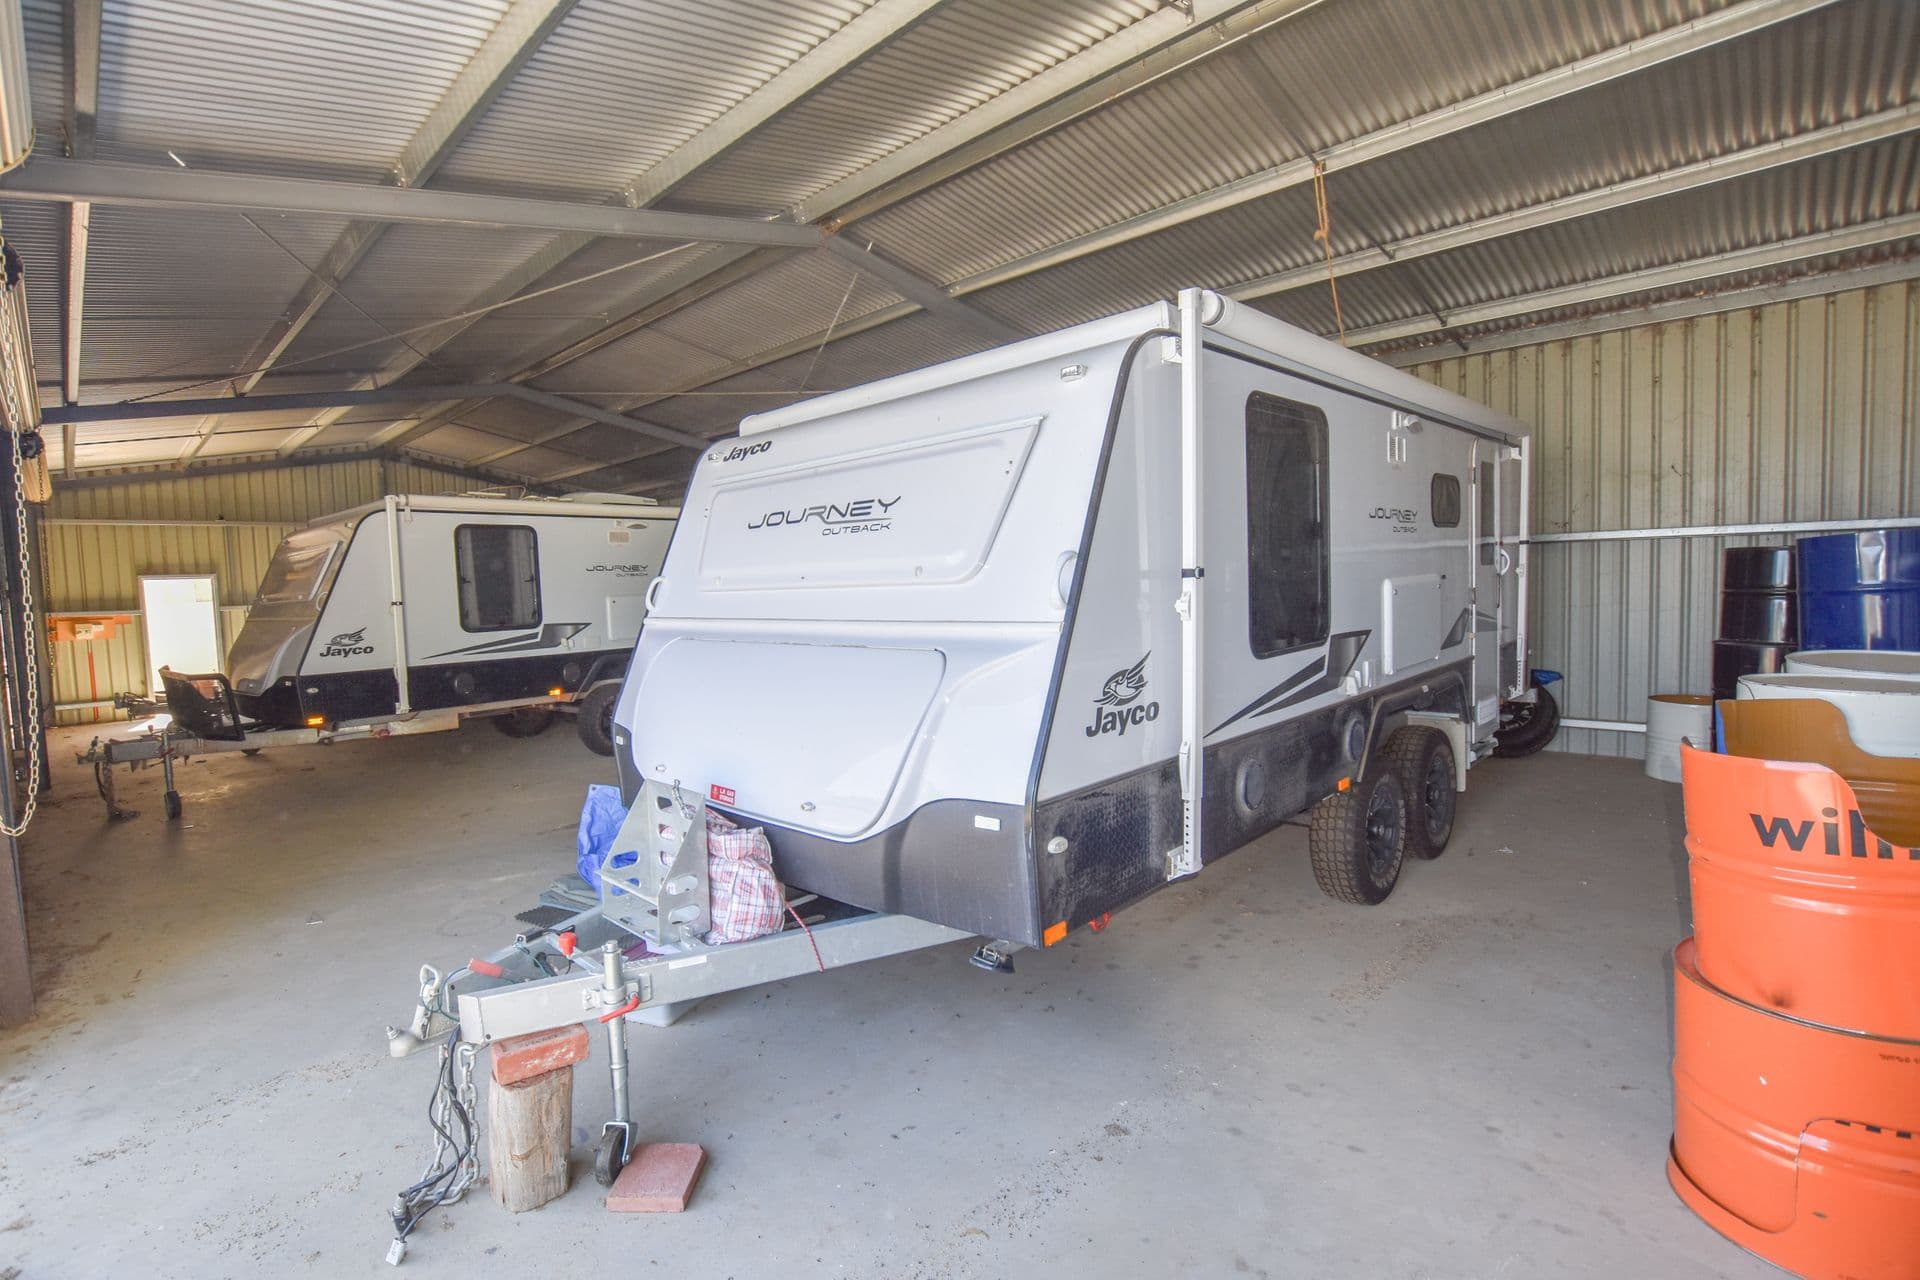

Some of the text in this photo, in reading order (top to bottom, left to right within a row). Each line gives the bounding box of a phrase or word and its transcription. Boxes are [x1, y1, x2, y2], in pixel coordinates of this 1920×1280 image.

[722, 439, 773, 462] Jayco
[747, 495, 902, 529] JOURNEY
[1368, 507, 1418, 521] JOURNEY
[821, 521, 892, 536] OUTBACK
[585, 564, 649, 572] JOURNEY
[319, 645, 375, 658] Jayco
[1085, 701, 1160, 738] Jayco
